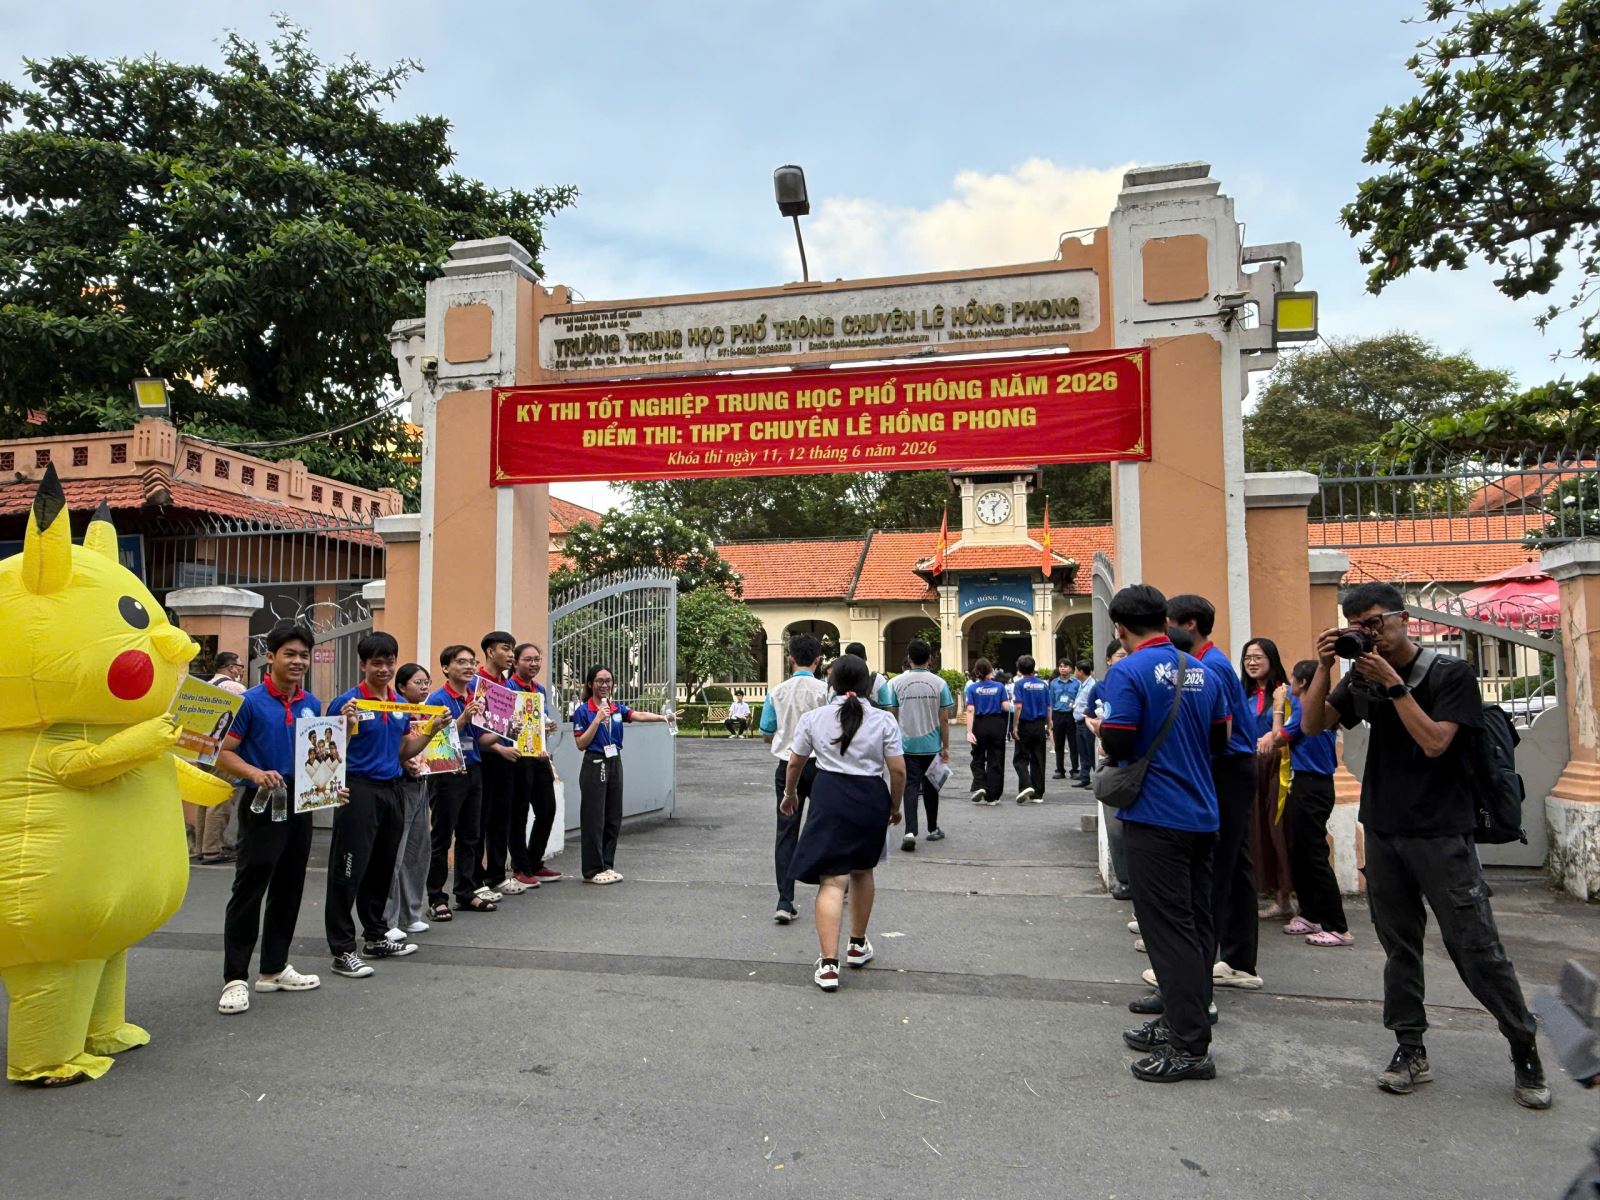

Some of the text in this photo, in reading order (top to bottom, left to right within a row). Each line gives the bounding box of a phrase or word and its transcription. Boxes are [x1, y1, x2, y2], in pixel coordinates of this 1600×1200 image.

[554, 297, 1080, 358] TRƯỜNG TRUNG HỌC PHỔ THÔNG CHUYÊN LÊ HỒNG PHONG
[516, 371, 1118, 423] KỲ THI TỐT NGHIỆP TRUNG HỌC PHỔ THÔNG NĂM 2026
[582, 406, 1037, 448] ĐIỂM THI: THPT CHUYÊN LÊ HỒNG PHONG
[667, 440, 937, 467] Khóa thi ngày 11, 12 tháng 6 năm 2026
[1002, 595, 1027, 606] PHONG
[1185, 673, 1204, 685] 2024
[345, 852, 353, 878] NIKE
